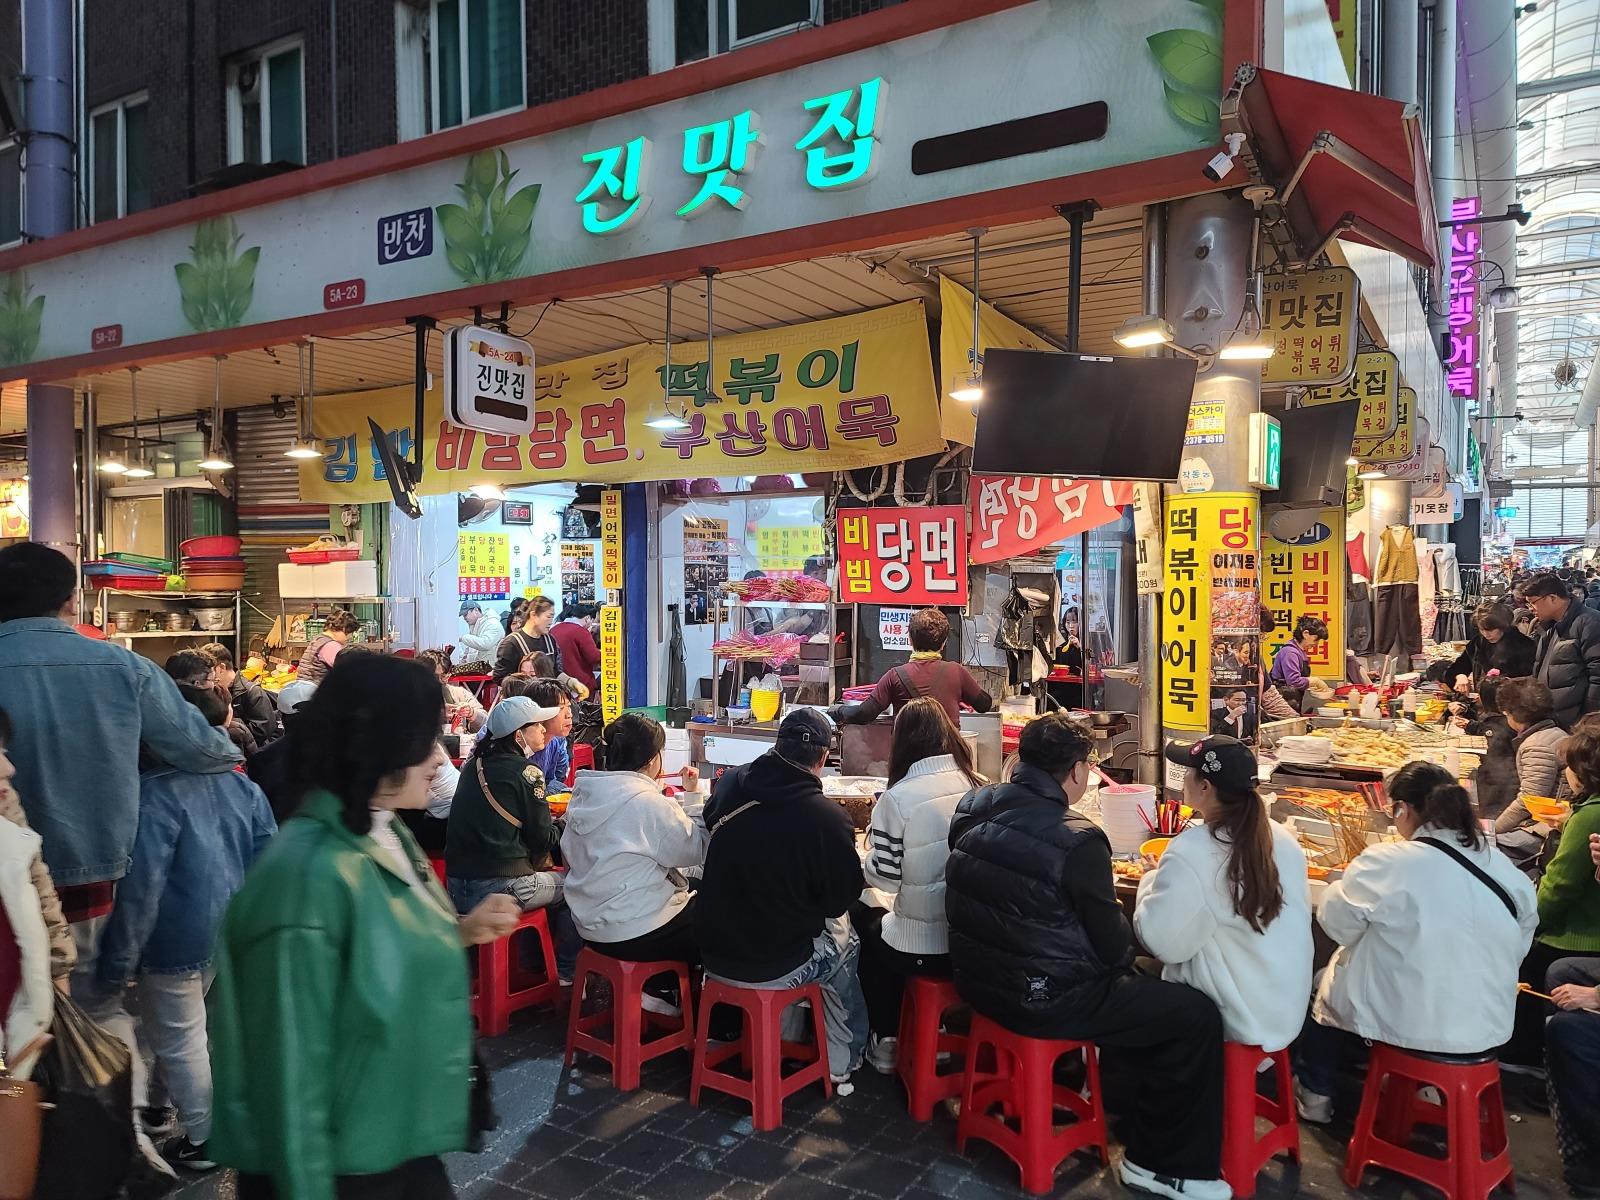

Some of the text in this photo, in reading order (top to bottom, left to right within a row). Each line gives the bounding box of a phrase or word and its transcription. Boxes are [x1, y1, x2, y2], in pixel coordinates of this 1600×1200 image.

[383, 216, 427, 261] 반찬
[1318, 274, 1343, 284] 2-21
[330, 285, 358, 303] 5A-23
[95, 331, 117, 344] 5A-22
[488, 348, 514, 362] 5A-24
[1309, 336, 1322, 374] 어묵
[1327, 334, 1342, 373] 튀김
[477, 364, 526, 400] 진맛집
[656, 339, 859, 407] 떡볶이
[659, 394, 901, 460] 부산어묵
[1362, 402, 1372, 431] 어묵
[1376, 401, 1387, 430] 튀김
[606, 494, 617, 518] 밀면
[1411, 503, 1449, 514] 기옷장
[605, 522, 618, 545] 어묵
[606, 548, 618, 584] 떡볶이
[844, 515, 872, 593] 비빔
[876, 517, 957, 592] 당면
[1213, 554, 1255, 569] 이재용
[604, 610, 617, 632] 김밥
[883, 624, 902, 635] 사용
[605, 635, 617, 680] 비빔당면
